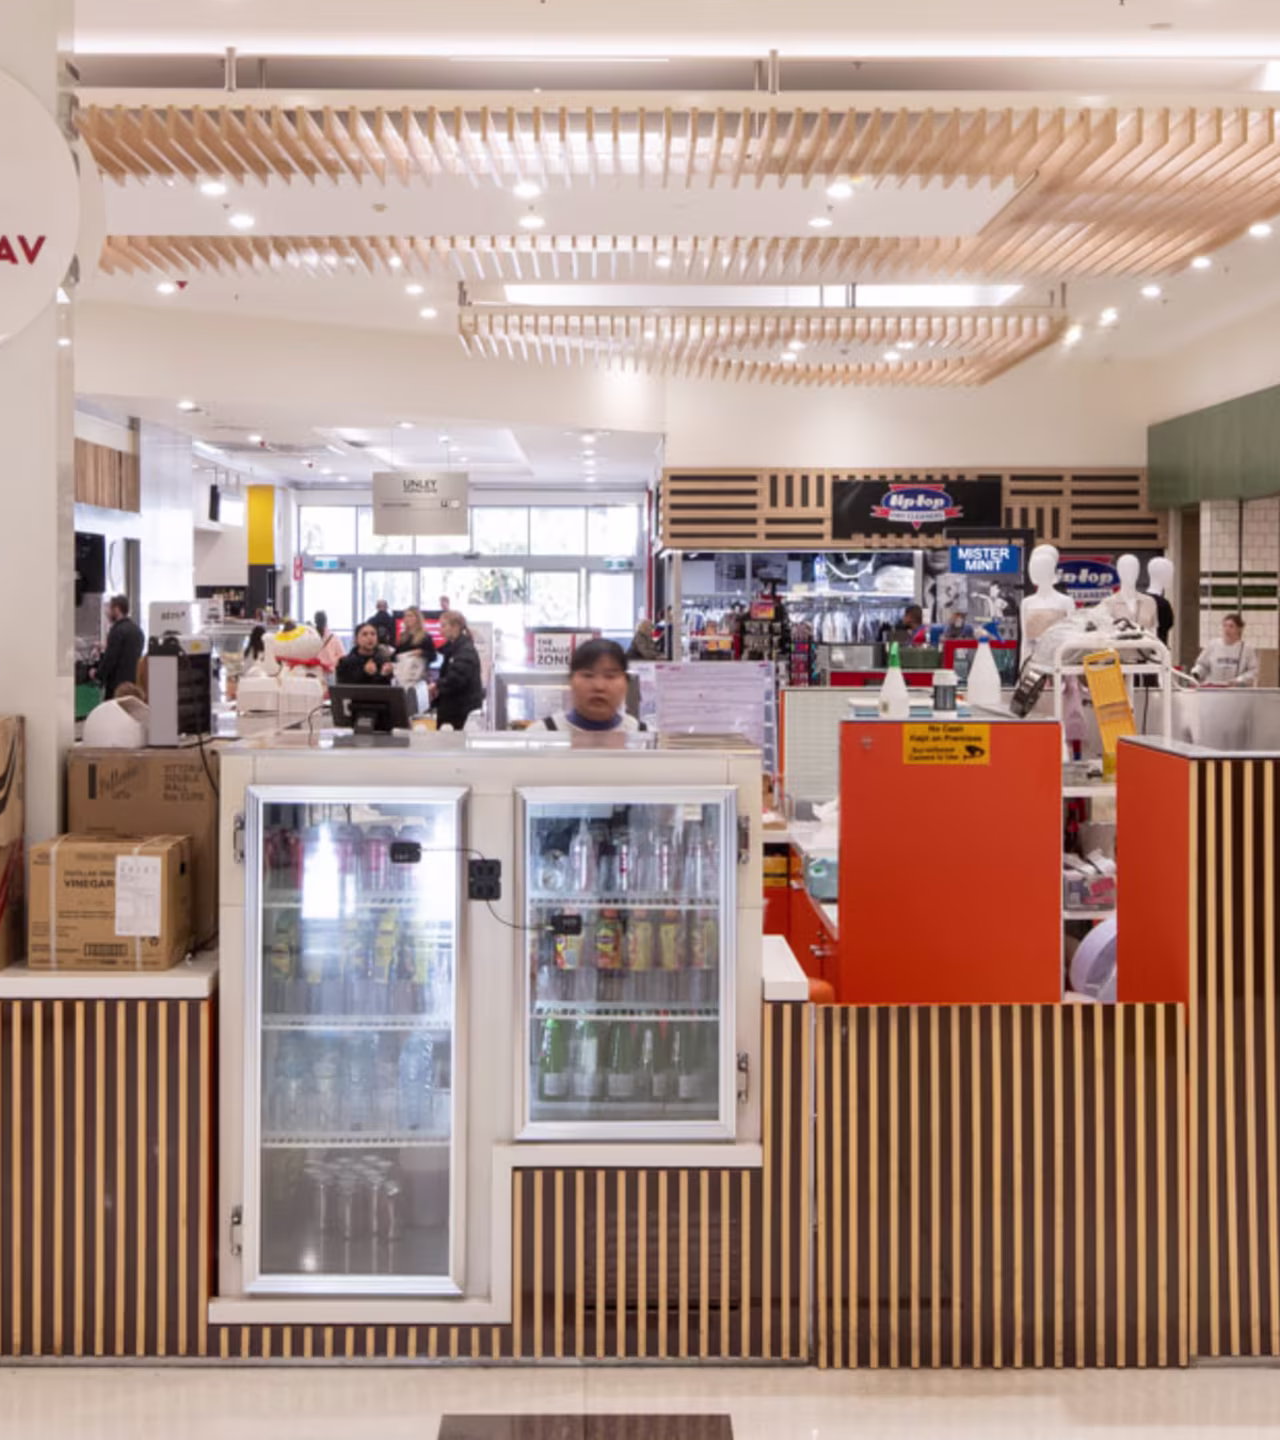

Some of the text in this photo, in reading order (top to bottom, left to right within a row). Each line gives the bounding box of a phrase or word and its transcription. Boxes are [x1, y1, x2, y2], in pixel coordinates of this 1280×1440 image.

[957, 547, 1010, 560] MISTER
[964, 560, 1003, 572] MINIT
[63, 879, 115, 889] VINEGAR
